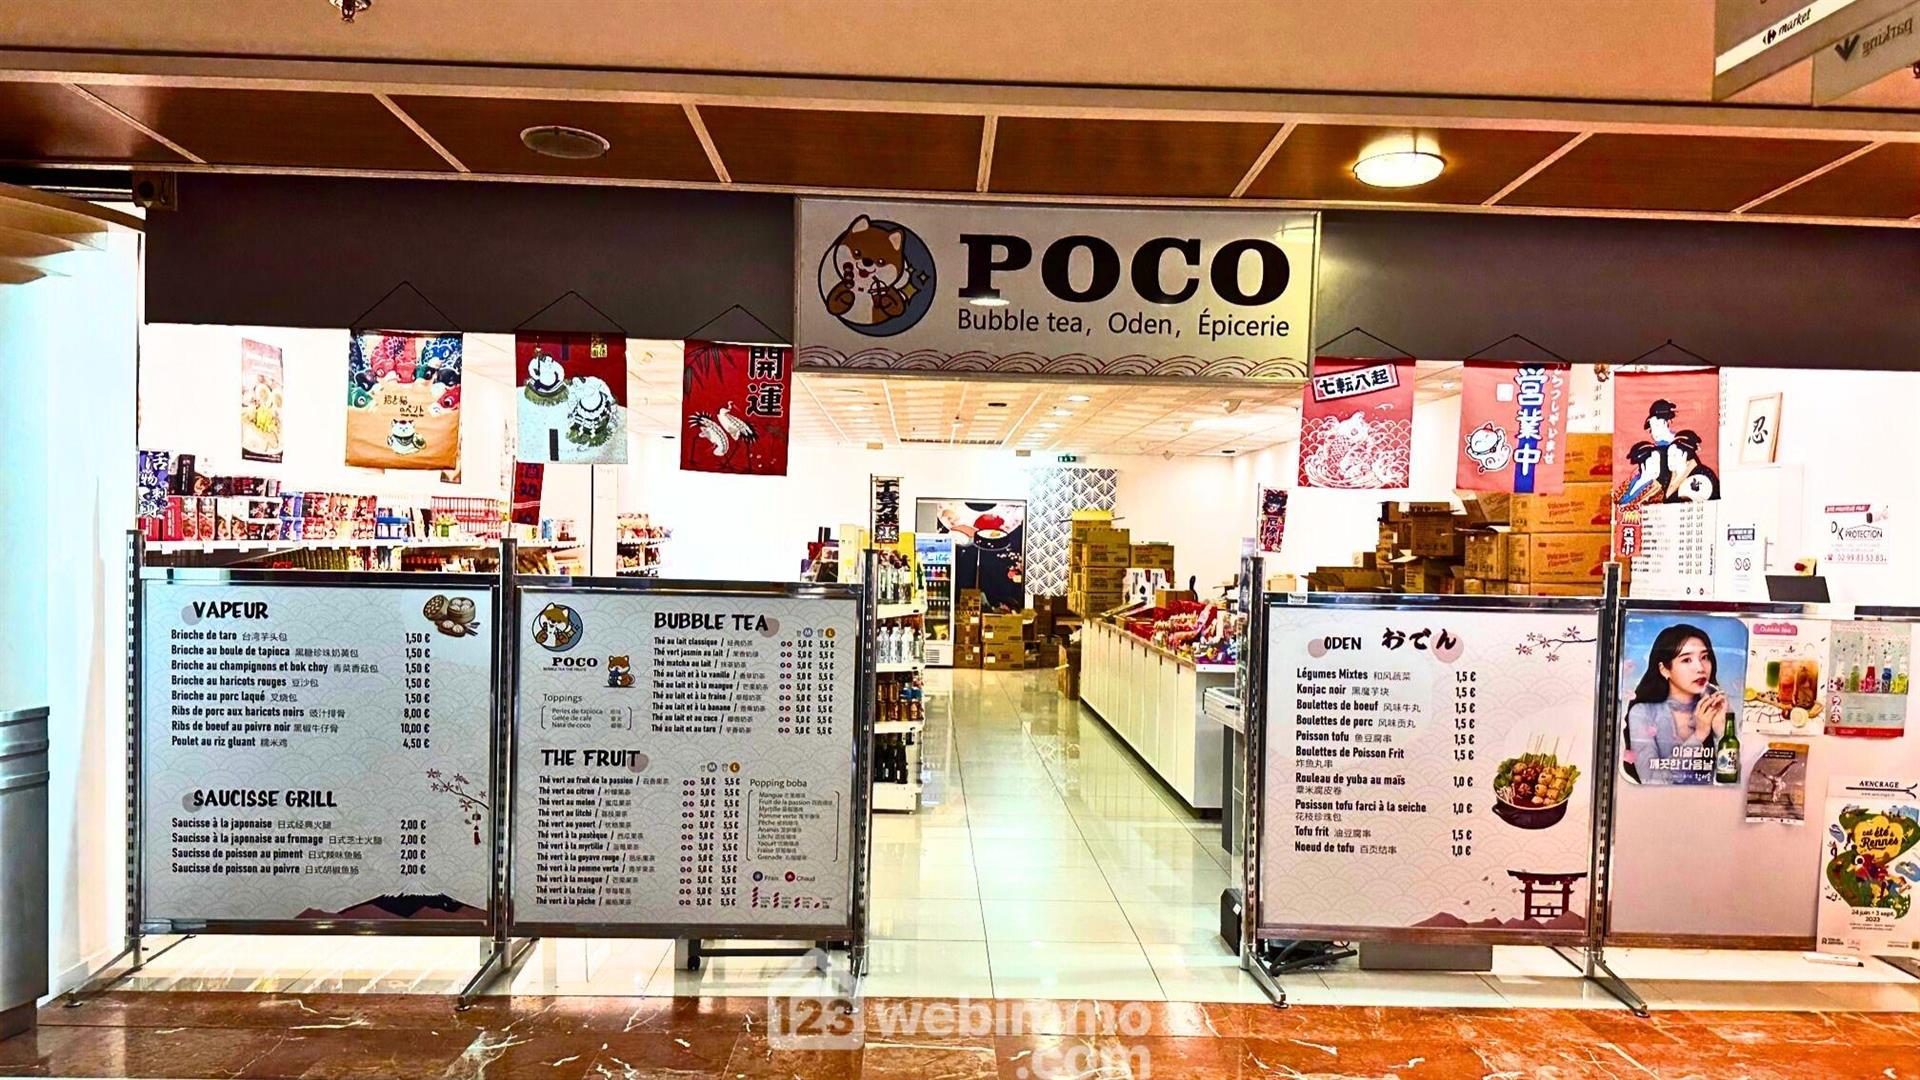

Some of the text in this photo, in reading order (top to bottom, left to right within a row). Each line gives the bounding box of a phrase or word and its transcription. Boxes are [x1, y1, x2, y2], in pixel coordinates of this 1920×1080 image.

[1778, 7, 1812, 36] market
[959, 234, 1290, 306] POCO
[958, 308, 1288, 341] Bubble tea, Oden, Épicerie
[745, 346, 785, 418] 開運
[1319, 368, 1389, 395] 七転八起
[1513, 368, 1550, 476] 営業中
[1747, 415, 1770, 445] 忍
[1845, 529, 1883, 539] PROTECTION
[192, 601, 268, 618] VAPEUR
[654, 612, 768, 631] BUBBLE TEA
[171, 629, 204, 639] Brioche
[206, 629, 216, 639] de
[219, 630, 237, 640] taro
[405, 632, 422, 644] 1,50
[424, 632, 430, 643] €
[1323, 627, 1456, 649] ODEN おでん
[171, 644, 204, 654] Brioche
[206, 647, 217, 655] au
[219, 645, 243, 655] boule
[245, 645, 256, 655] de
[258, 645, 290, 658] tapioca
[405, 647, 422, 659] 1,50
[424, 648, 430, 658] €
[171, 659, 204, 670] Brioche
[206, 662, 217, 670] au
[219, 660, 277, 673] champignons
[278, 661, 288, 671] et
[290, 660, 306, 671] bok
[307, 661, 328, 674] choy
[405, 662, 422, 674] 1,50
[424, 662, 430, 673] €
[552, 657, 597, 667] POCO
[171, 674, 204, 685] Brioche
[206, 677, 217, 685] au
[219, 675, 255, 686] haricots
[257, 678, 286, 688] rouges
[405, 677, 421, 689] 1,50
[424, 678, 430, 688] €
[1296, 667, 1336, 680] Légumes
[1338, 668, 1368, 679] Mixtes
[1455, 671, 1467, 683] 1,5
[1469, 671, 1476, 681] €
[171, 689, 204, 700] Brioche
[206, 692, 217, 700] au
[219, 692, 239, 703] porc
[241, 690, 265, 703] laqué
[405, 692, 421, 704] 1,50
[423, 693, 430, 703] €
[1296, 683, 1326, 696] Konjac
[1328, 684, 1346, 694] noir
[1455, 686, 1467, 698] 1,5
[1469, 687, 1475, 697] €
[543, 693, 582, 704] Toppings
[1296, 699, 1337, 710] Boulettes
[1340, 699, 1351, 710] de
[1353, 700, 1378, 710] boeuf
[1455, 702, 1466, 714] 1,5
[1469, 702, 1475, 713] €
[1296, 714, 1337, 725] Boulettes
[1339, 715, 1350, 726] de
[1353, 718, 1373, 728] porc
[1454, 718, 1466, 730] 1,5
[1468, 718, 1474, 729] €
[540, 749, 640, 766] THE FRUIT
[1672, 746, 1714, 758] 이슬같이
[1681, 759, 1714, 771] 다음날
[749, 778, 807, 789] Popping boba
[1859, 780, 1900, 788] AENCRAGE
[193, 789, 337, 807] SAUCISSE GRILL
[1335, 800, 1353, 810] tofu
[1355, 800, 1376, 811] farci
[1378, 800, 1384, 811] à
[1386, 801, 1395, 811] la
[1397, 801, 1426, 812] seiche
[1452, 802, 1464, 815] 1,0
[1466, 803, 1472, 813] €
[172, 817, 210, 827] Saucisse
[212, 817, 218, 828] à
[220, 817, 229, 827] la
[230, 817, 272, 830] japonaise
[400, 819, 417, 831] 2,00
[420, 819, 426, 829] €
[1873, 825, 1890, 837] été
[1294, 841, 1321, 852] Noeud
[1323, 842, 1334, 852] de
[1336, 842, 1354, 852] tofu
[1451, 844, 1463, 856] 1,0
[1465, 845, 1471, 856] €
[1859, 836, 1899, 851] Rennes
